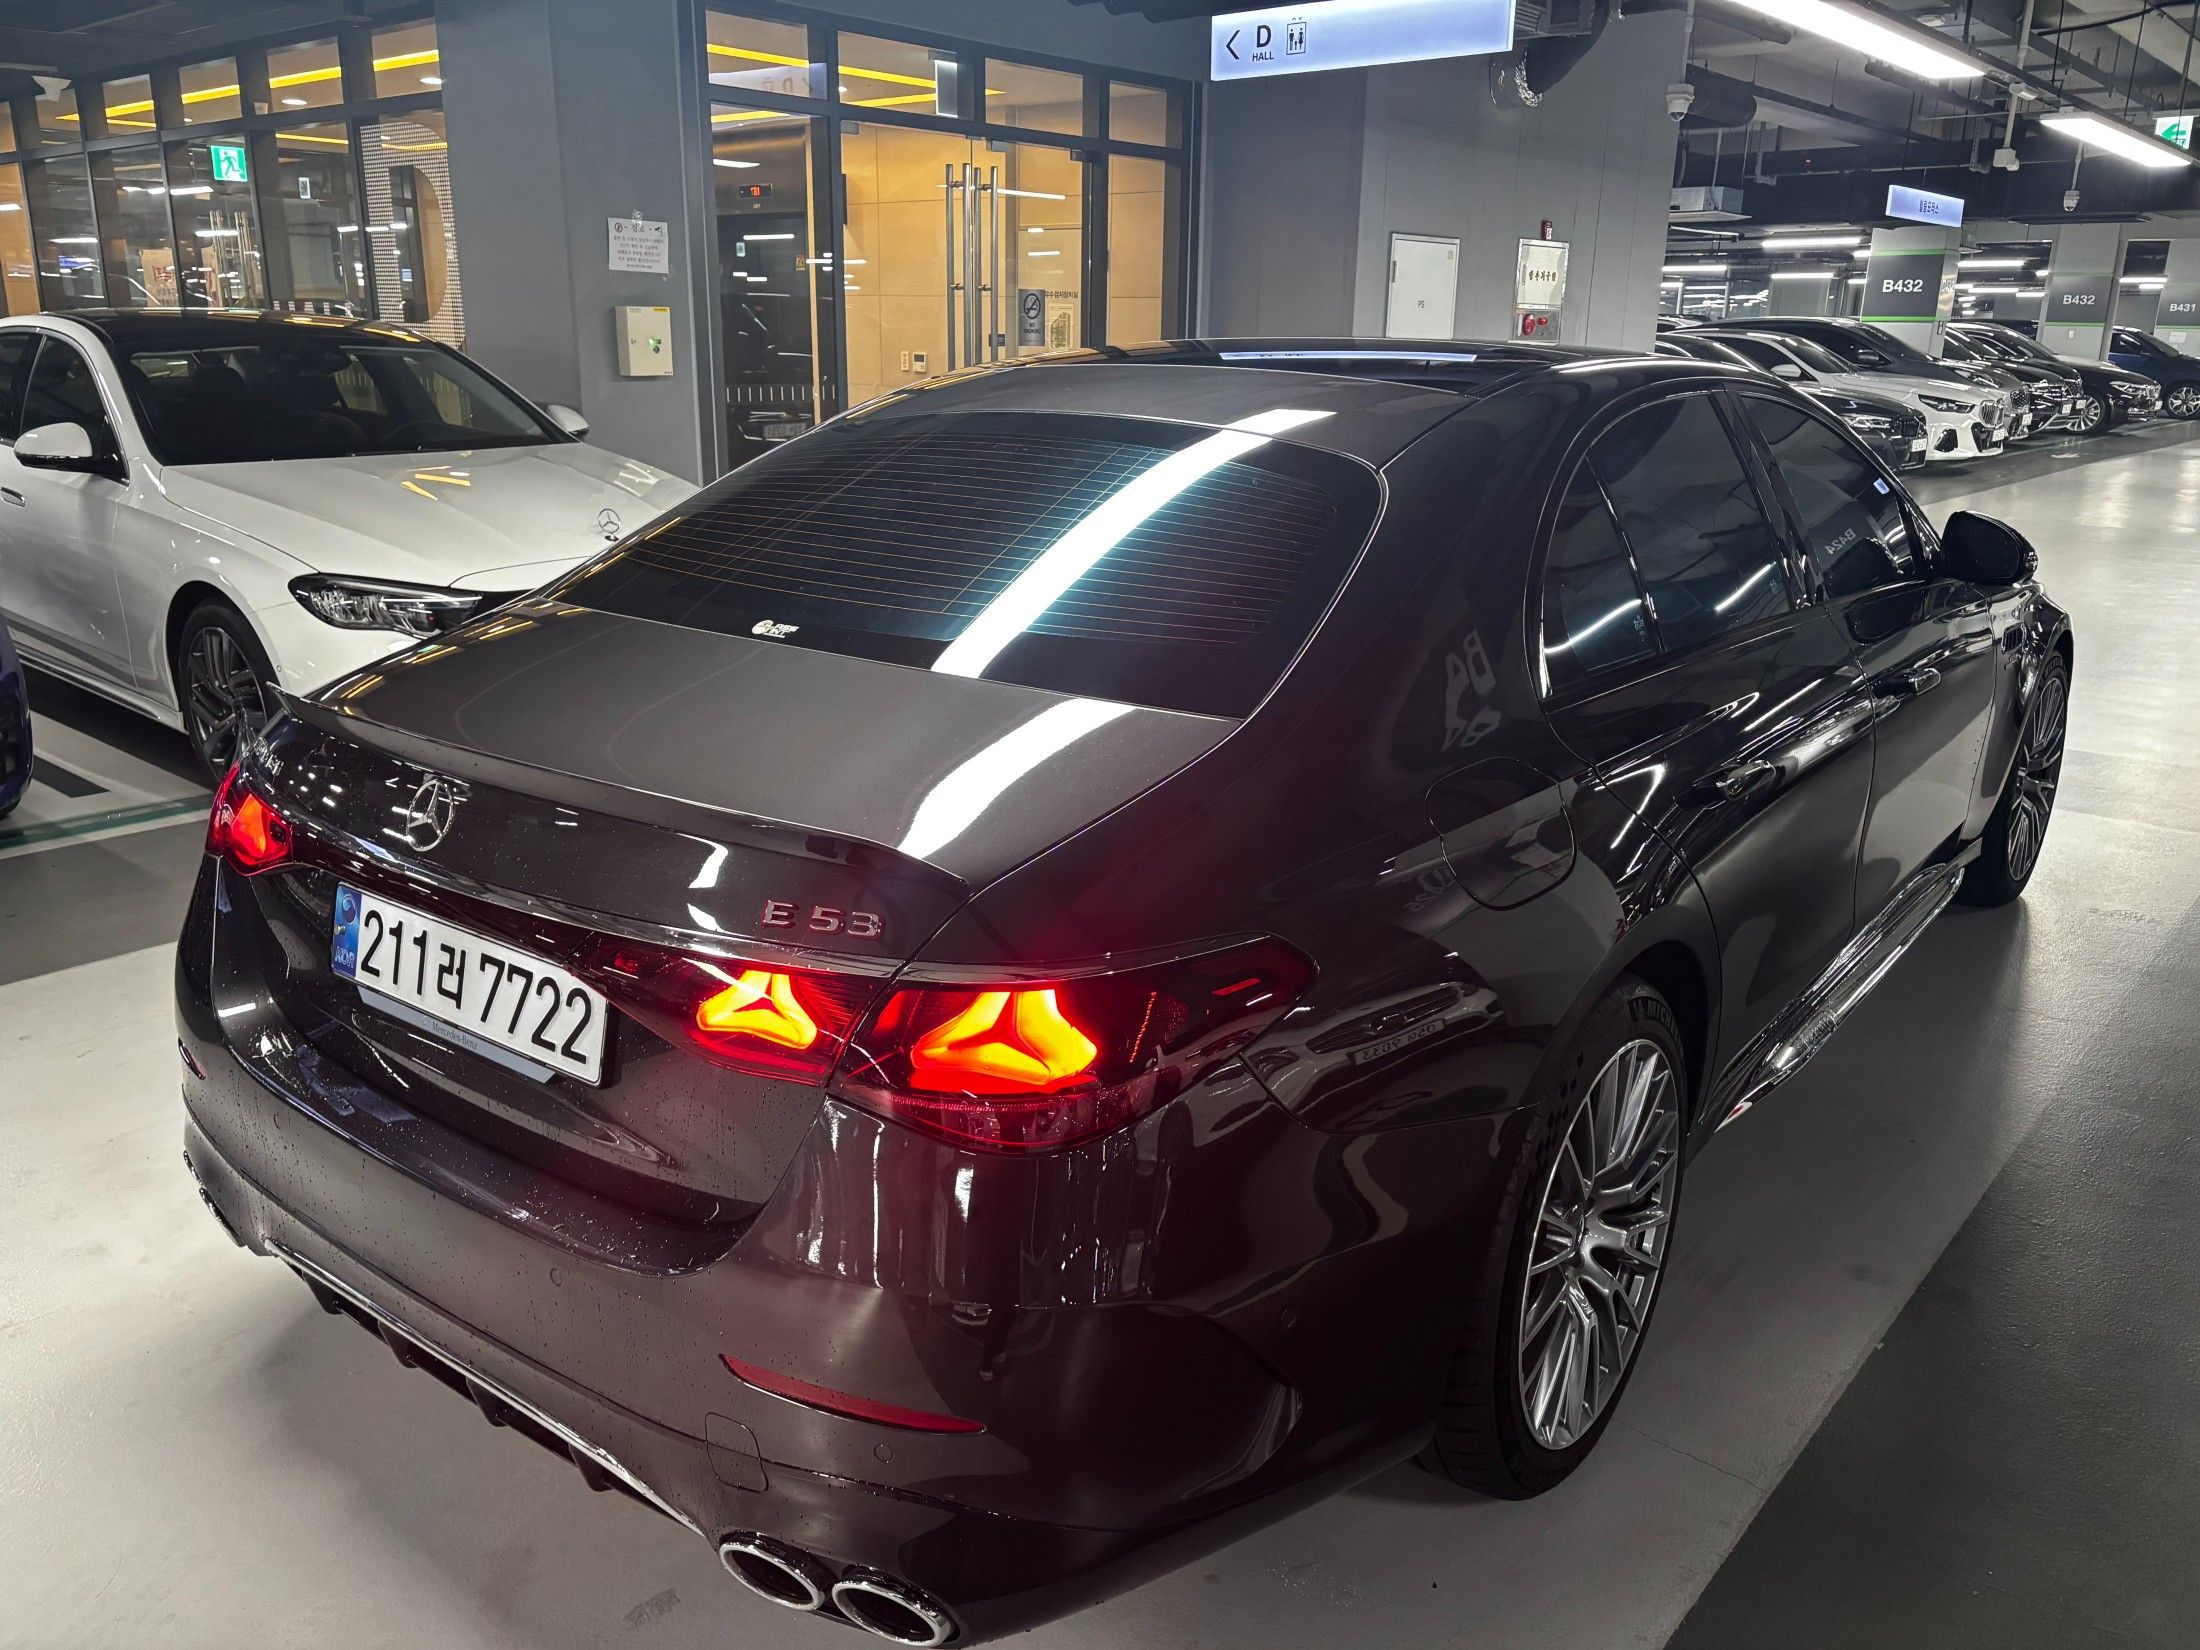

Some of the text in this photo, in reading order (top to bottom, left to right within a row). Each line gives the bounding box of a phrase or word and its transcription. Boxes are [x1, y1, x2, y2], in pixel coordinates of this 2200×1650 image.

[1256, 24, 1272, 48] D
[1252, 51, 1275, 62] HALL
[1882, 279, 1924, 293] B432
[1417, 300, 1425, 309] PS
[2062, 294, 2096, 305] B432
[2169, 303, 2196, 312] B431
[763, 900, 882, 940] E 53
[335, 946, 355, 969] KOR
[360, 909, 592, 1065] 211러 7722
[431, 1020, 479, 1050] Mercedes-Benz
